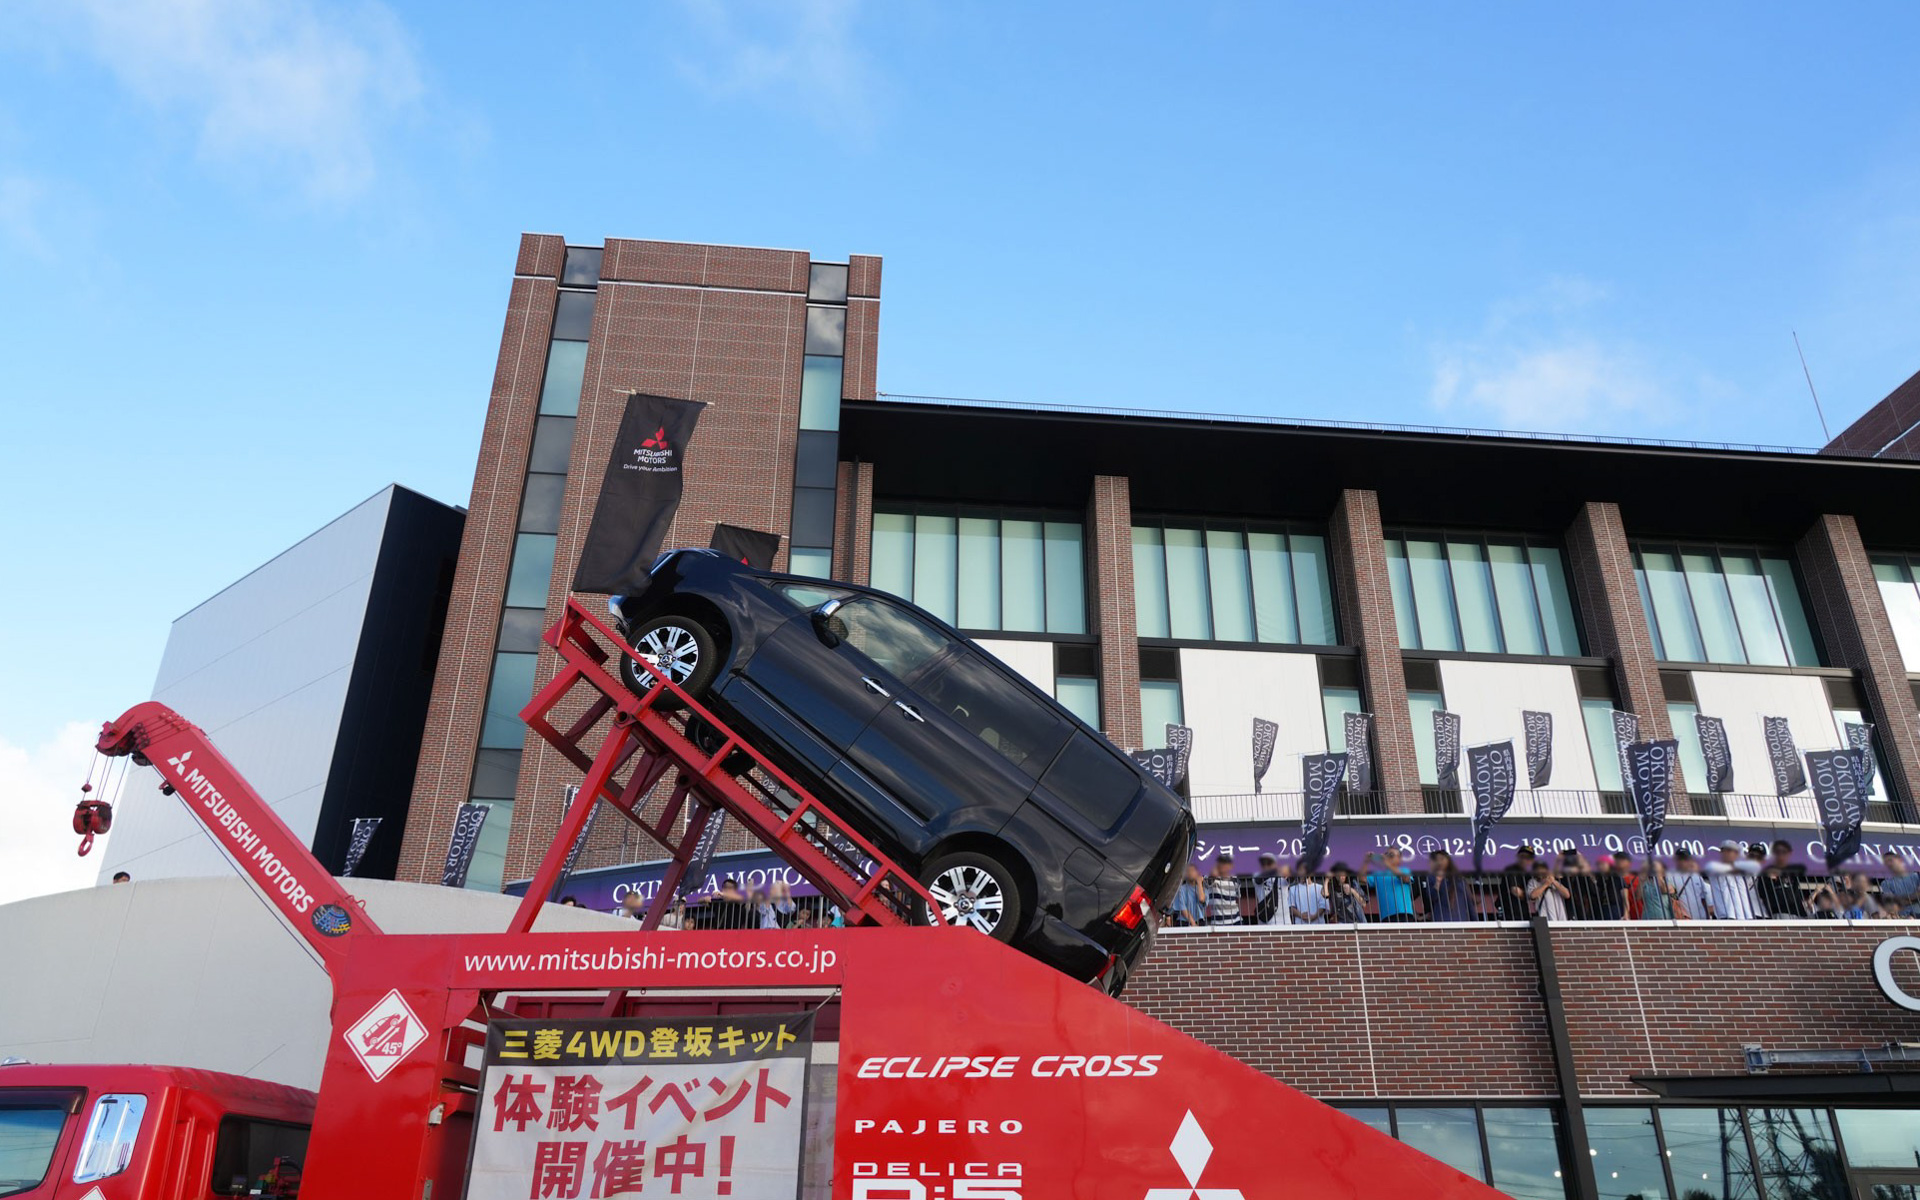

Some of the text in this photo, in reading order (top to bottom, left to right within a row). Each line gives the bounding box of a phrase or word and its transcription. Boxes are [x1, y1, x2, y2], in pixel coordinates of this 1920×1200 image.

[637, 455, 667, 464] MOTORS
[1349, 759, 1361, 791] SHOW
[1766, 720, 1790, 794] MOTOR SHOW
[1475, 754, 1492, 819] MOTOR
[1650, 746, 1665, 830] OKINAWA
[1813, 757, 1845, 826] MOTOR
[184, 768, 315, 914] MITSUBISHI MOTORS
[447, 810, 470, 867] MOTOR
[464, 944, 837, 972] www.mitsubishi-motors.co.jp
[381, 1042, 403, 1055] 45°
[499, 1023, 798, 1060] 三菱4WD登坂キット
[857, 1055, 1163, 1079] ECLIPSE CROSS
[493, 1067, 792, 1133] 体験イベント
[854, 1119, 1024, 1135] PAJERO
[529, 1134, 737, 1200] 開催中!
[852, 1162, 1023, 1177] DELICA
